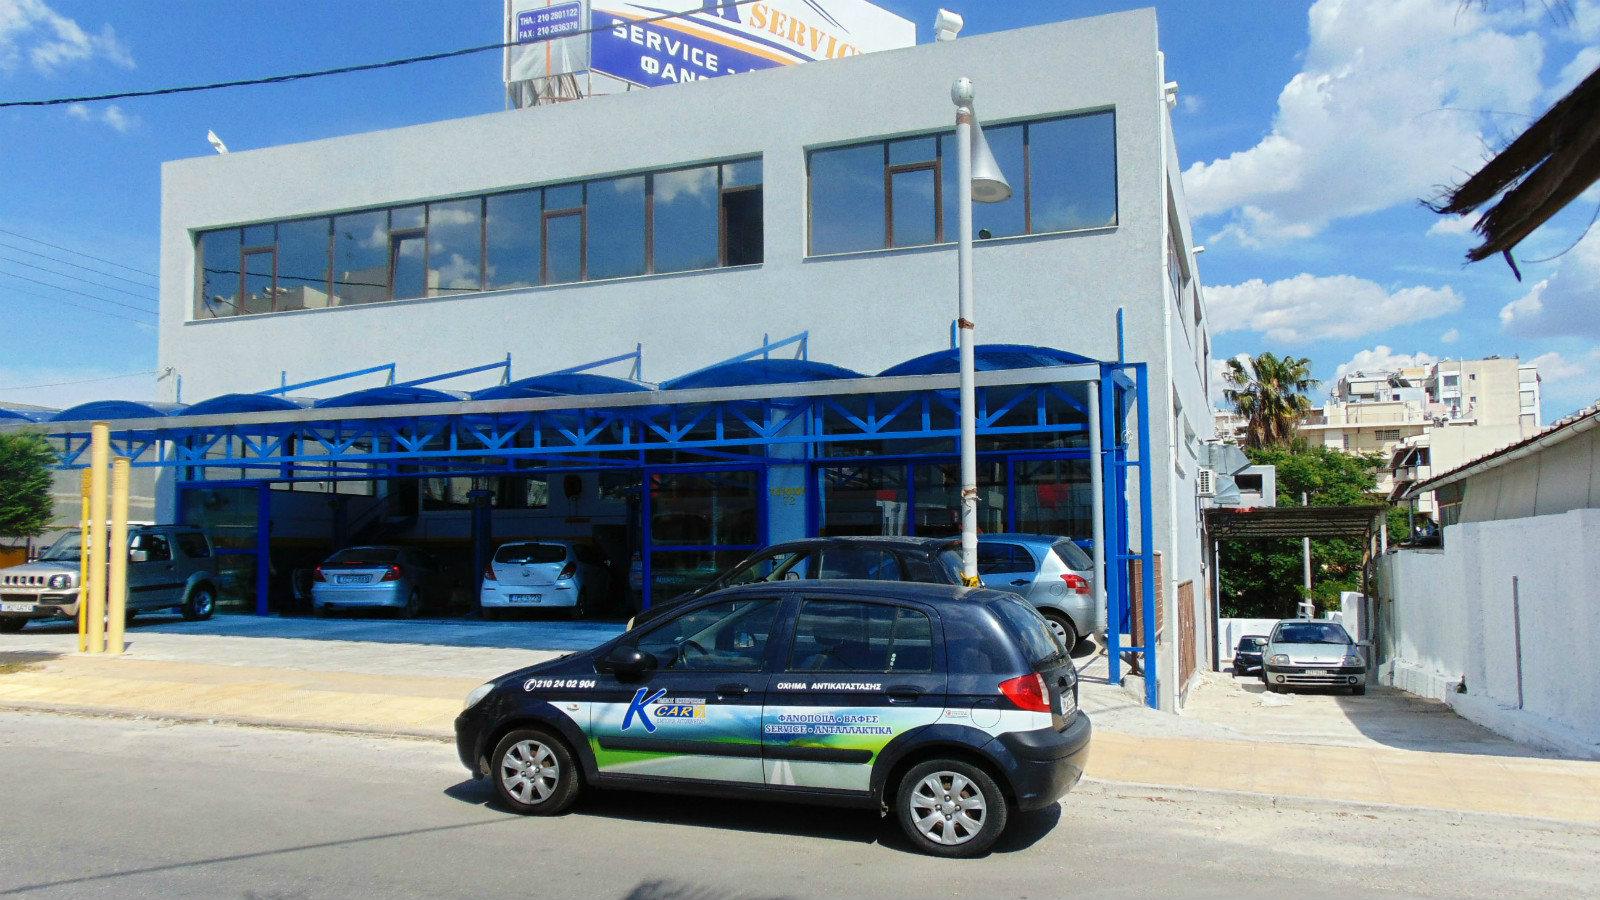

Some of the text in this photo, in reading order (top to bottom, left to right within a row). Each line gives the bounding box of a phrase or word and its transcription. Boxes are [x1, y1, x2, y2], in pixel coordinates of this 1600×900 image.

[537, 14, 550, 23] 210
[519, 21, 578, 39] FAX: 210 2836378
[750, 2, 863, 59] SERVIC
[612, 18, 718, 71] SERVICE
[536, 680, 596, 689] 210 24 02 904
[777, 682, 882, 691] ΟΧΗΜΑ ΑΝΤΙΚΑΤΑΣΤΑΣΗΣ
[620, 687, 693, 733] K CAR
[844, 715, 879, 724] ΒΑΦΕΣ
[765, 724, 893, 735] SERVICE ΑΝΤΑΛΛΑΚΤΙΚΑ
